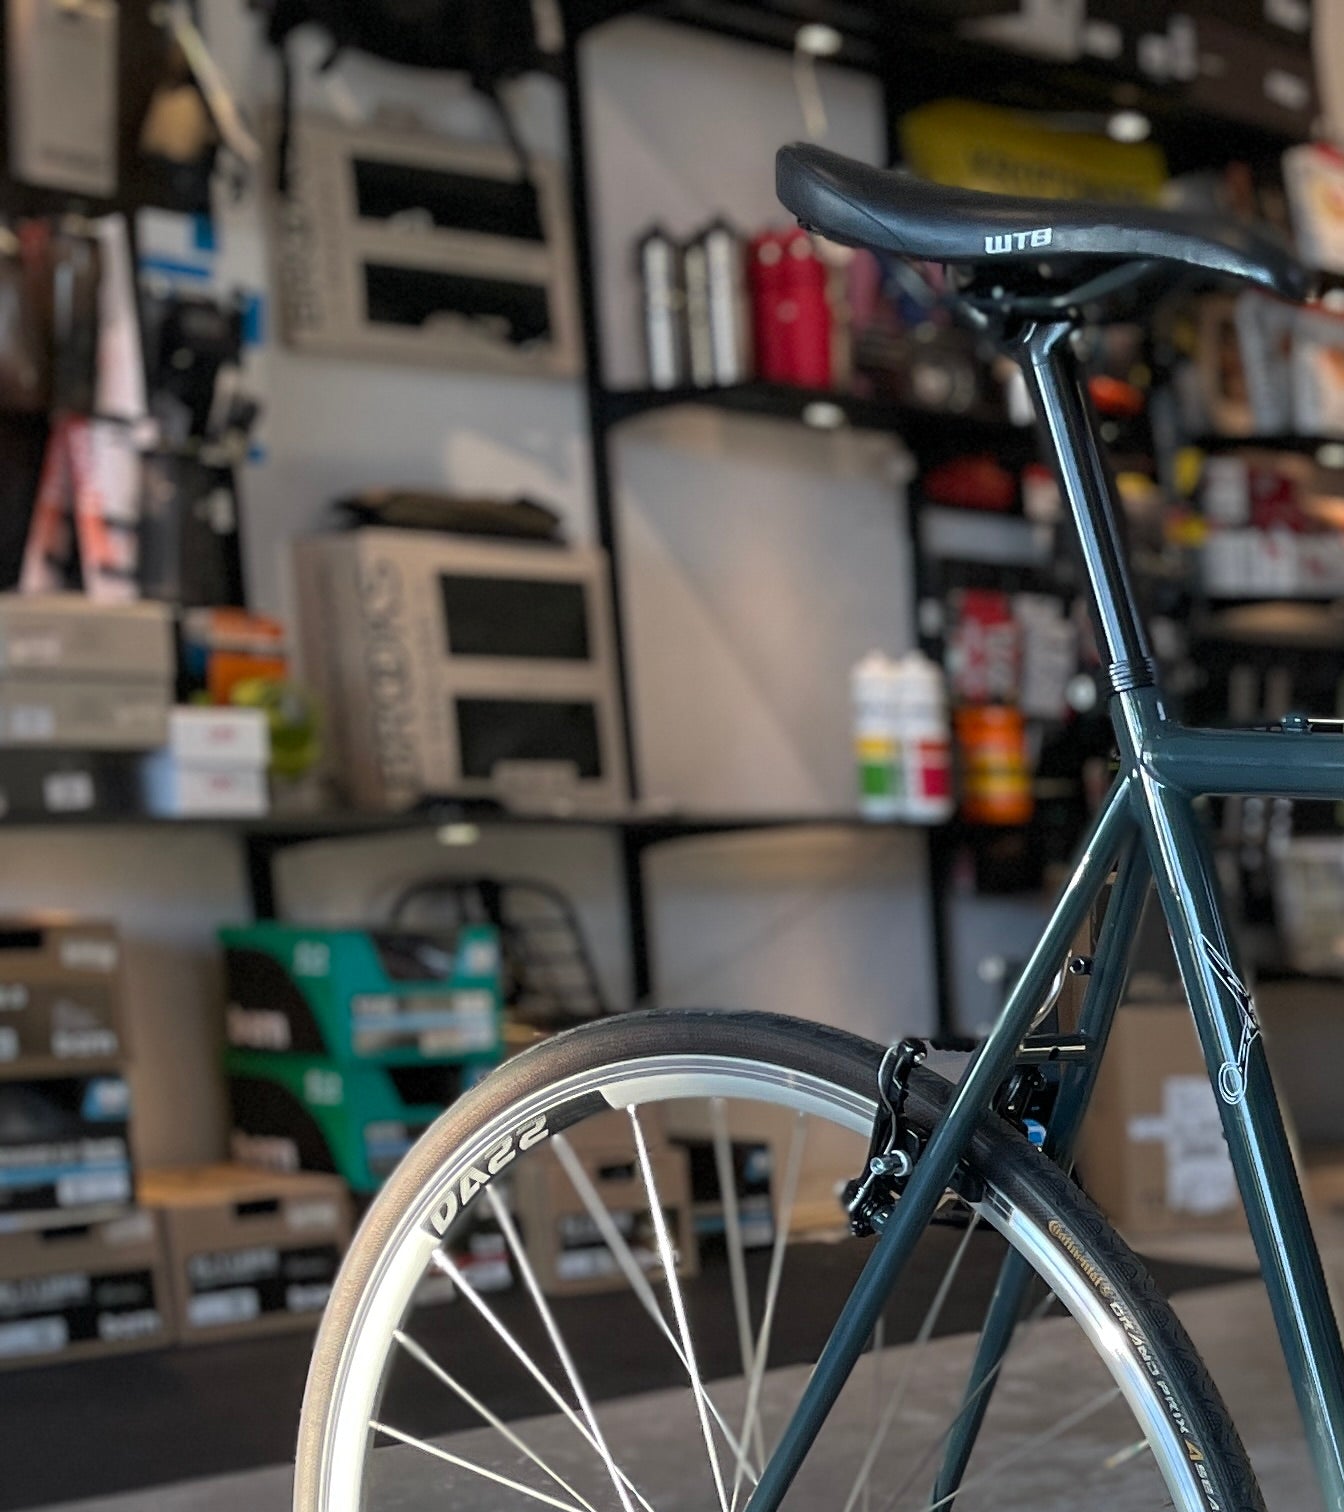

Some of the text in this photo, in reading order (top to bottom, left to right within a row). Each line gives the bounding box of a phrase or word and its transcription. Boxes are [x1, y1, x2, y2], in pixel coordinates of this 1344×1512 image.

[984, 227, 1053, 255] WTB
[430, 1115, 550, 1237] DA22
[1048, 1220, 1104, 1287] Continental
[1110, 1302, 1160, 1376] GRAND
[1157, 1381, 1189, 1434] PRIX
